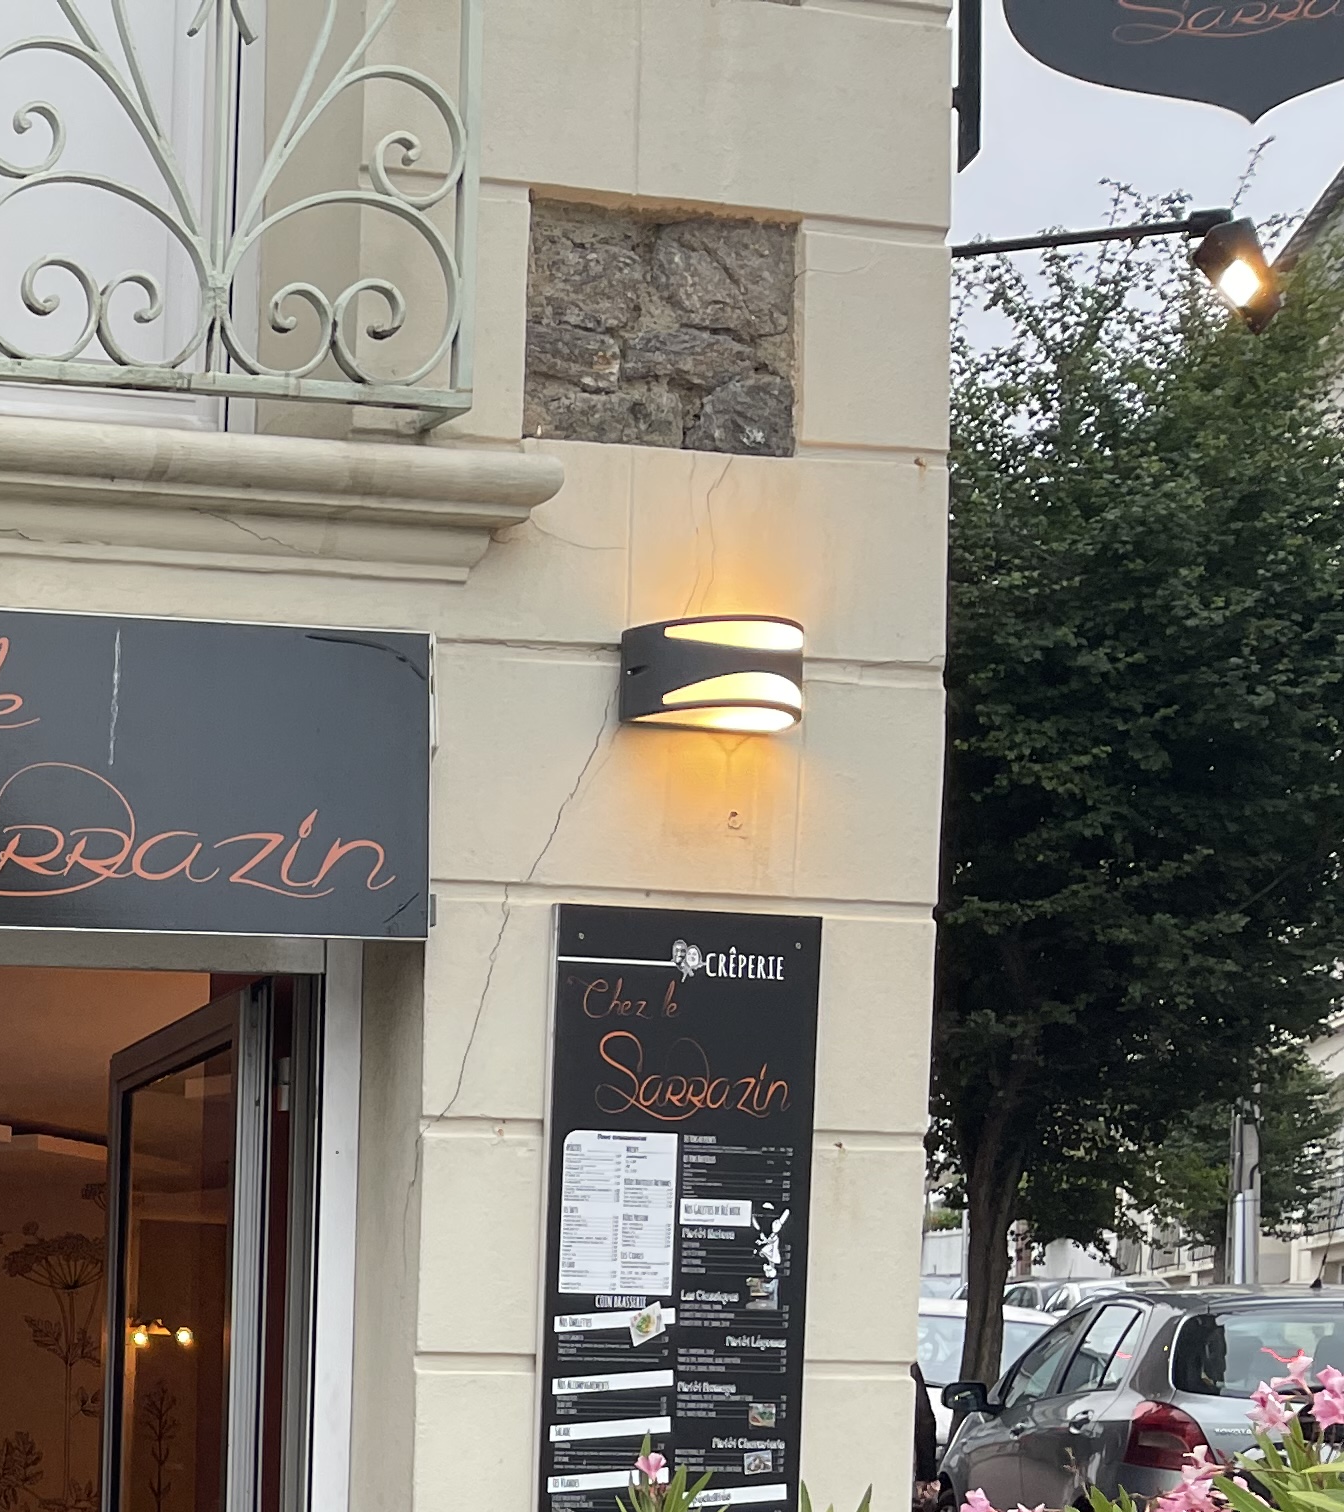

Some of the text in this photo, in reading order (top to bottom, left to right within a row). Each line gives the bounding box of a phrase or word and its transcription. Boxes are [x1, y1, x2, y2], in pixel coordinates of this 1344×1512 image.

[705, 946, 785, 980] CRÊPERIE
[567, 975, 681, 1019] Chez le
